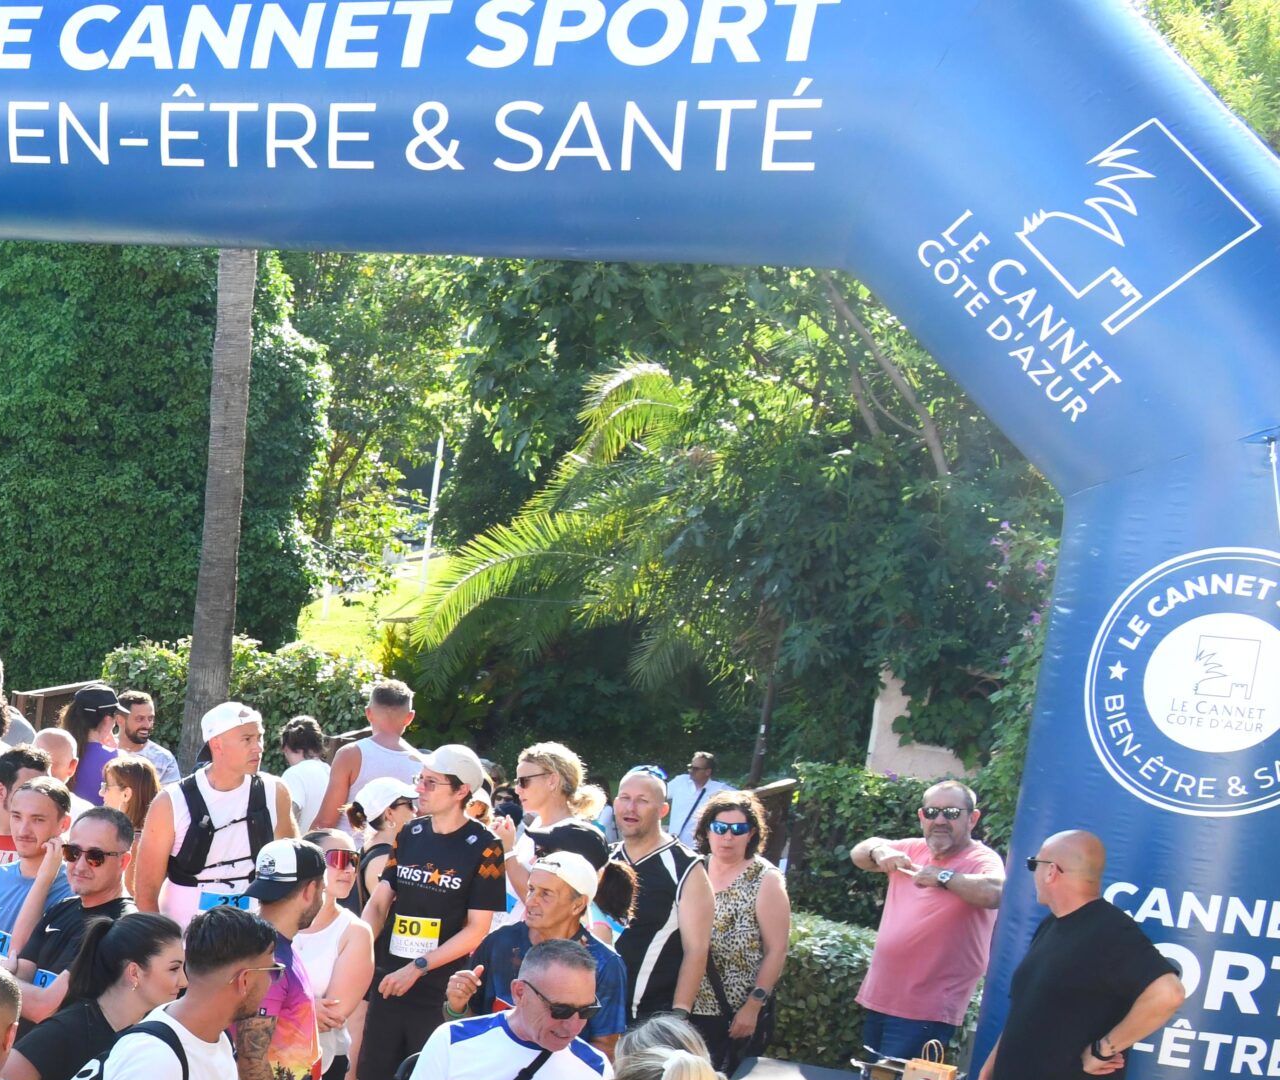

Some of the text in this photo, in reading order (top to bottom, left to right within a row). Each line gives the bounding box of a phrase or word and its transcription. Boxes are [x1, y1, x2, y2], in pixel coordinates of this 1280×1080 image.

[59, 1, 452, 71] CANNET
[465, 0, 840, 68] SPORT
[405, 100, 465, 171] &
[493, 77, 823, 172] SANTÉ
[941, 209, 1122, 395] LE CANNET
[986, 315, 1088, 422] D'AZUR
[1118, 573, 1277, 651] LE CANNET
[1104, 694, 1217, 798] BIEN-ÊTRE
[1227, 775, 1249, 797] &
[1170, 698, 1266, 720] LE CANNET
[398, 919, 421, 936] 50
